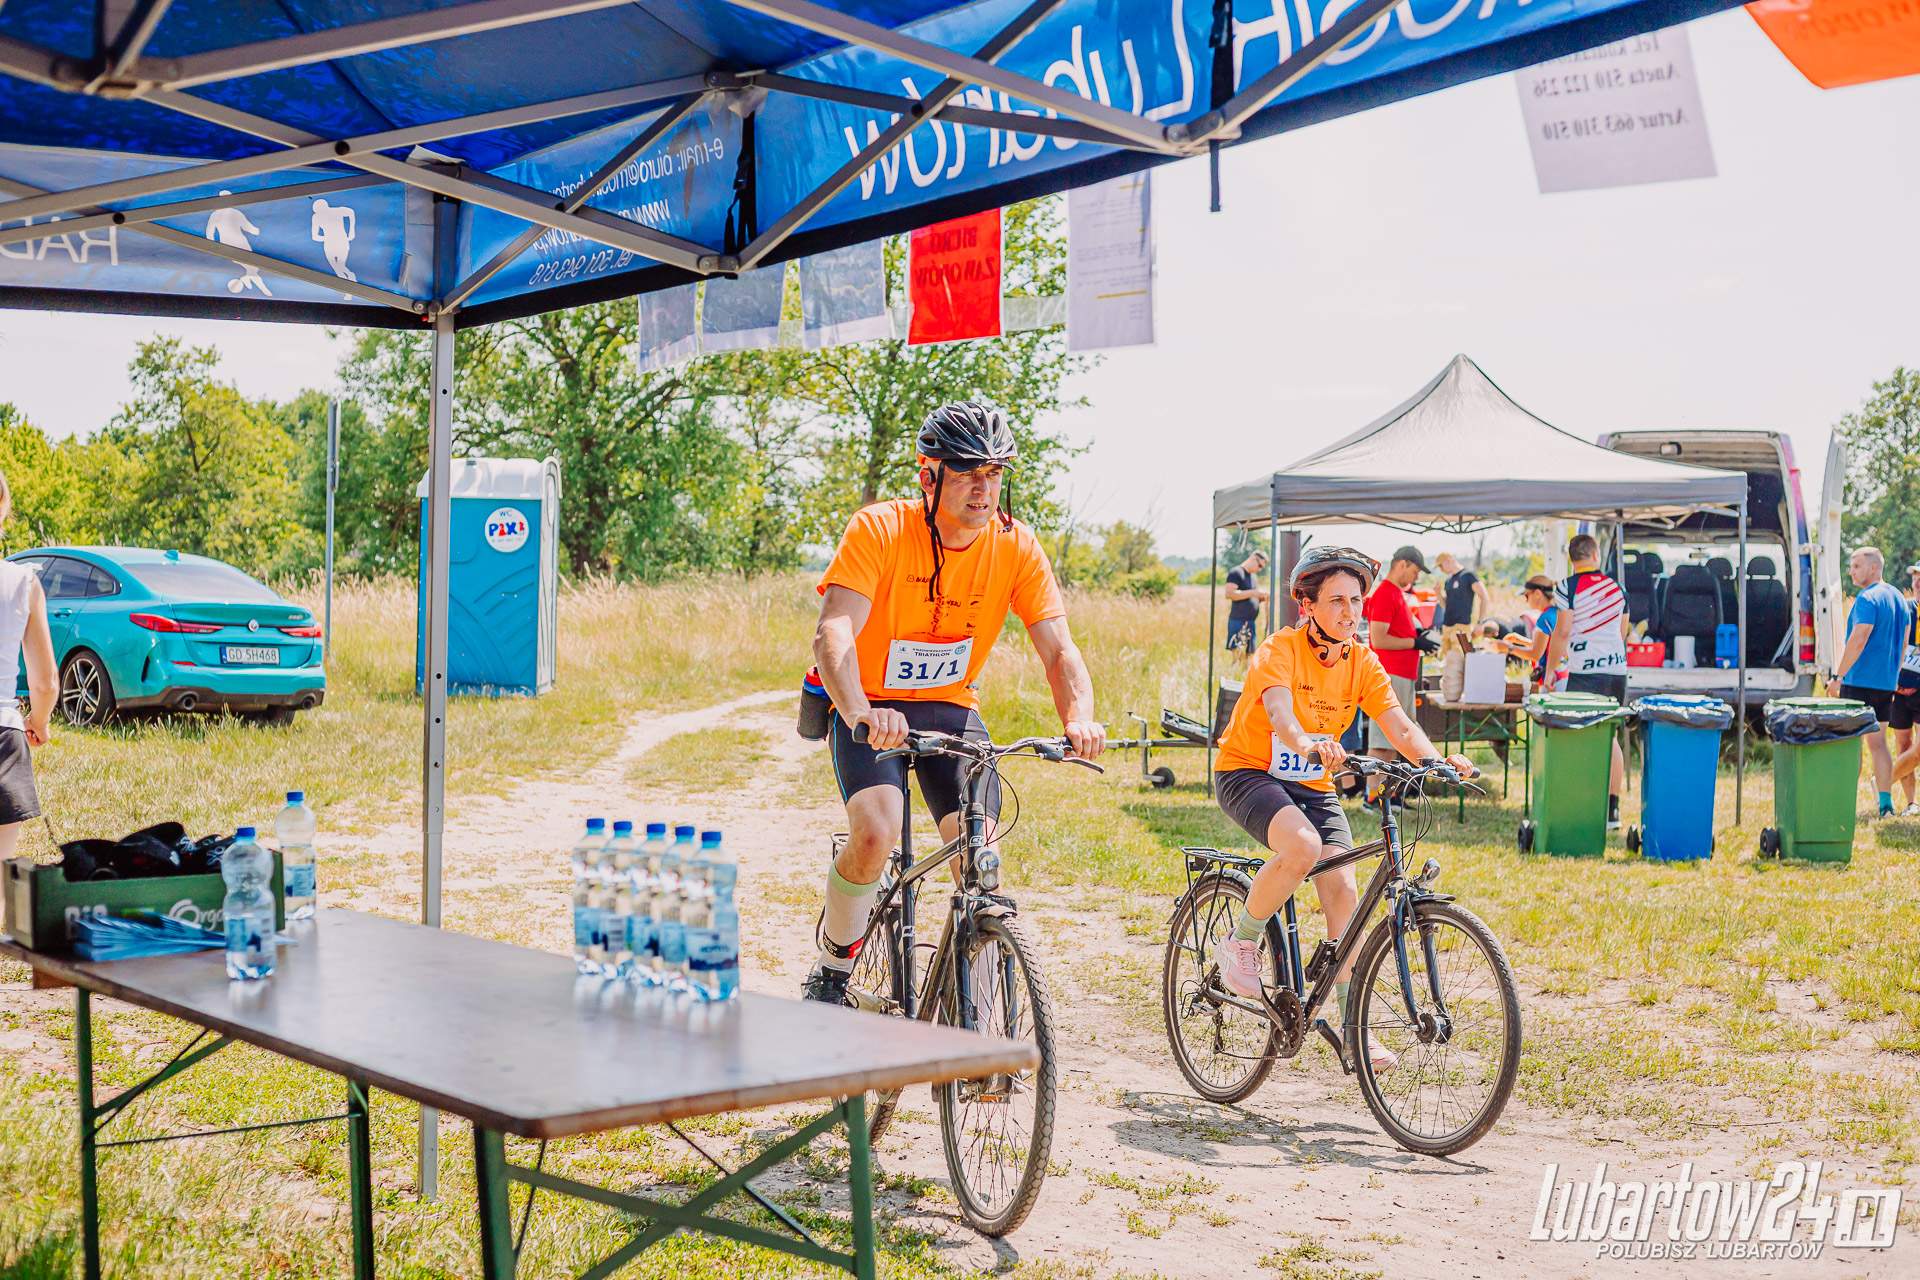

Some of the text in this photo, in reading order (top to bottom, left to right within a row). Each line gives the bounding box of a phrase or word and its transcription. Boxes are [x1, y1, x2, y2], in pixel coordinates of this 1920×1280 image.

[228, 648, 277, 662] GD 5H468
[897, 659, 959, 680] 31/1
